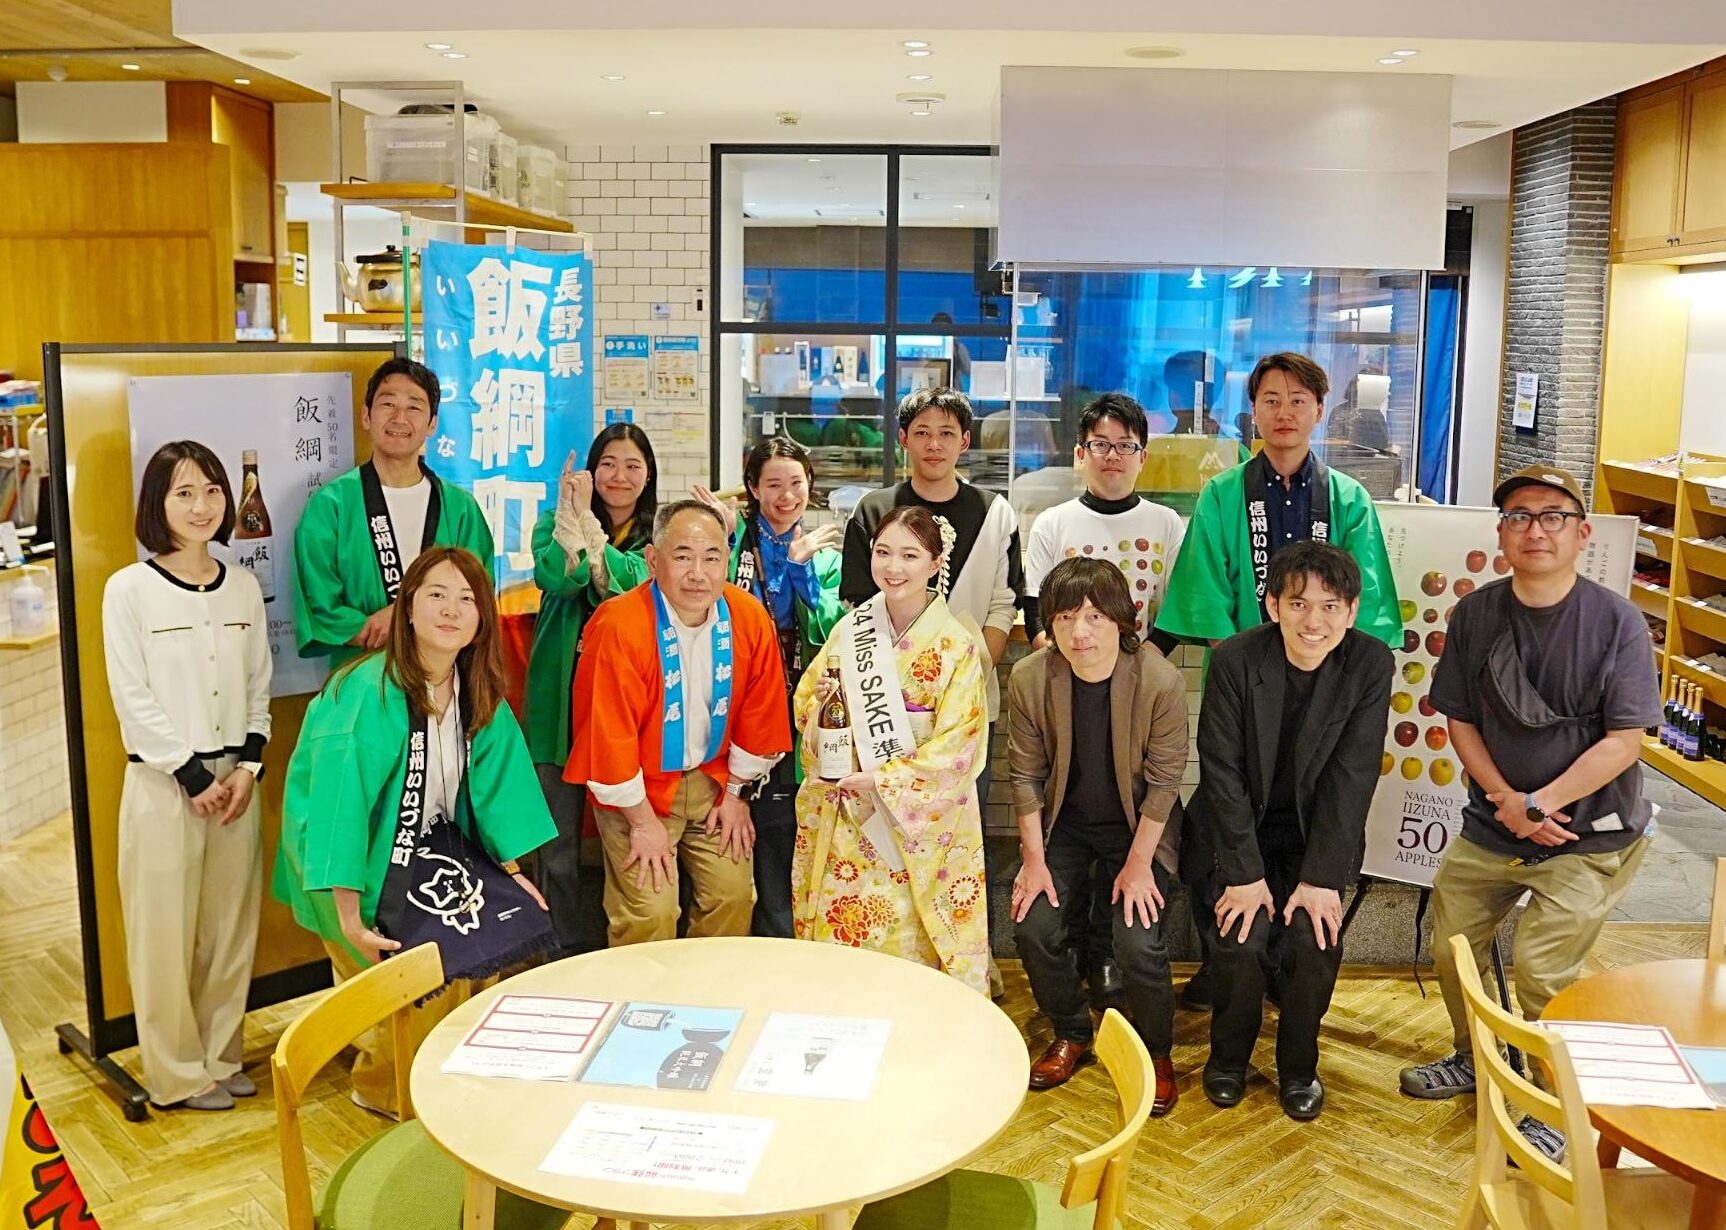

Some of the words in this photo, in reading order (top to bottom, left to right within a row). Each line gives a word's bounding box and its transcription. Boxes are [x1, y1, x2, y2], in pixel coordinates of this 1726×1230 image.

[549, 266, 584, 378] 長野県
[436, 275, 459, 458] いいづな
[295, 396, 322, 462] 飯綱
[466, 257, 553, 571] 飯綱町
[307, 471, 322, 498] 試
[1311, 520, 1329, 543] 信
[854, 628, 878, 673] Miss
[860, 675, 894, 738] SAKE
[391, 731, 425, 867] 信州いいづな町
[1402, 801, 1451, 820] IIZUNA
[1404, 791, 1453, 807] NAGANO
[1397, 816, 1448, 854] 50
